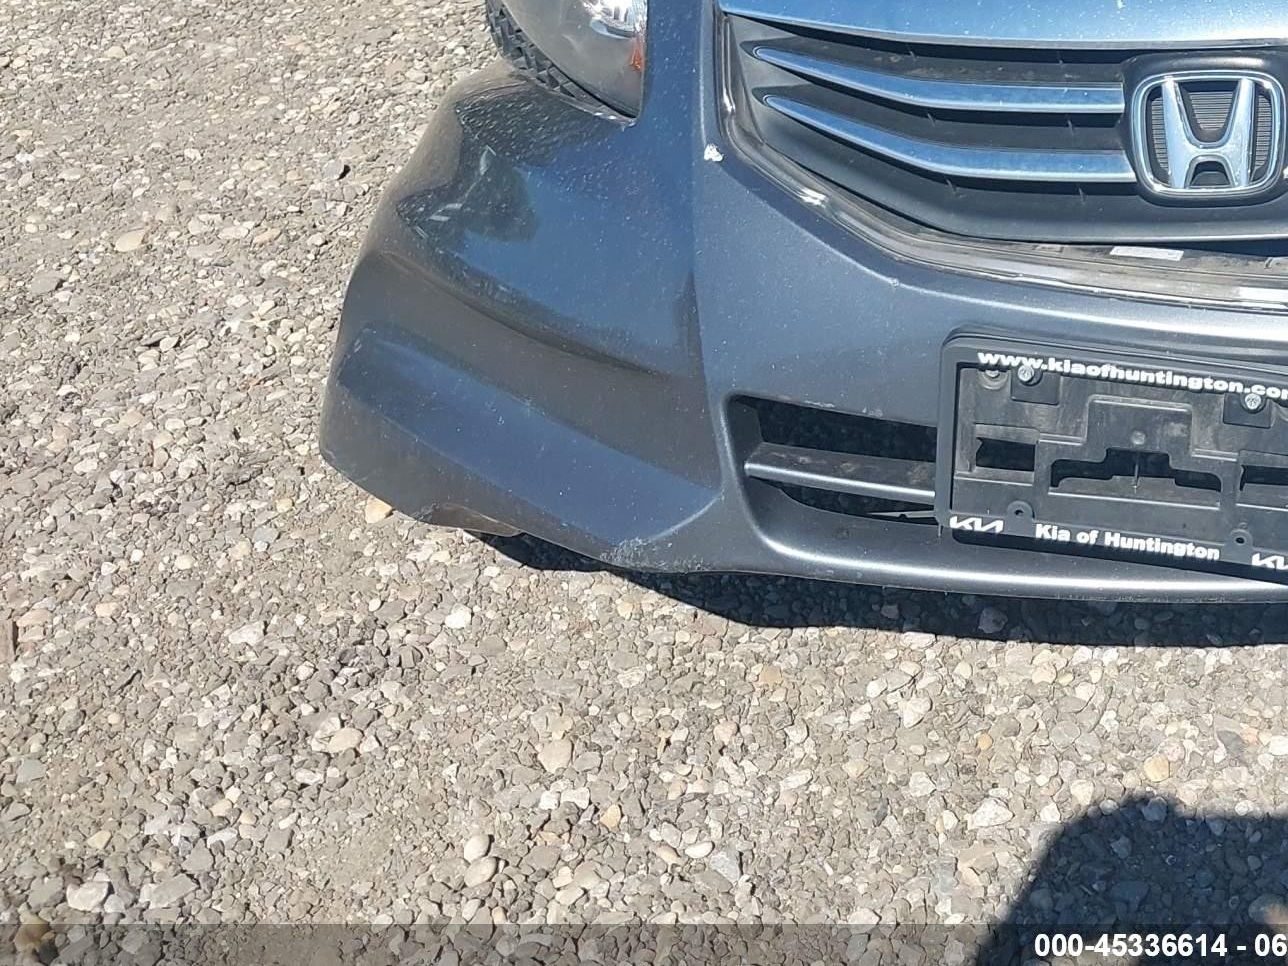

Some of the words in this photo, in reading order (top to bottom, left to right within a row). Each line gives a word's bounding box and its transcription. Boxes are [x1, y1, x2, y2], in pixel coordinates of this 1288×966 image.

[1035, 522, 1071, 542] Kia
[1076, 529, 1098, 545] of
[1104, 531, 1220, 561] Huntington
